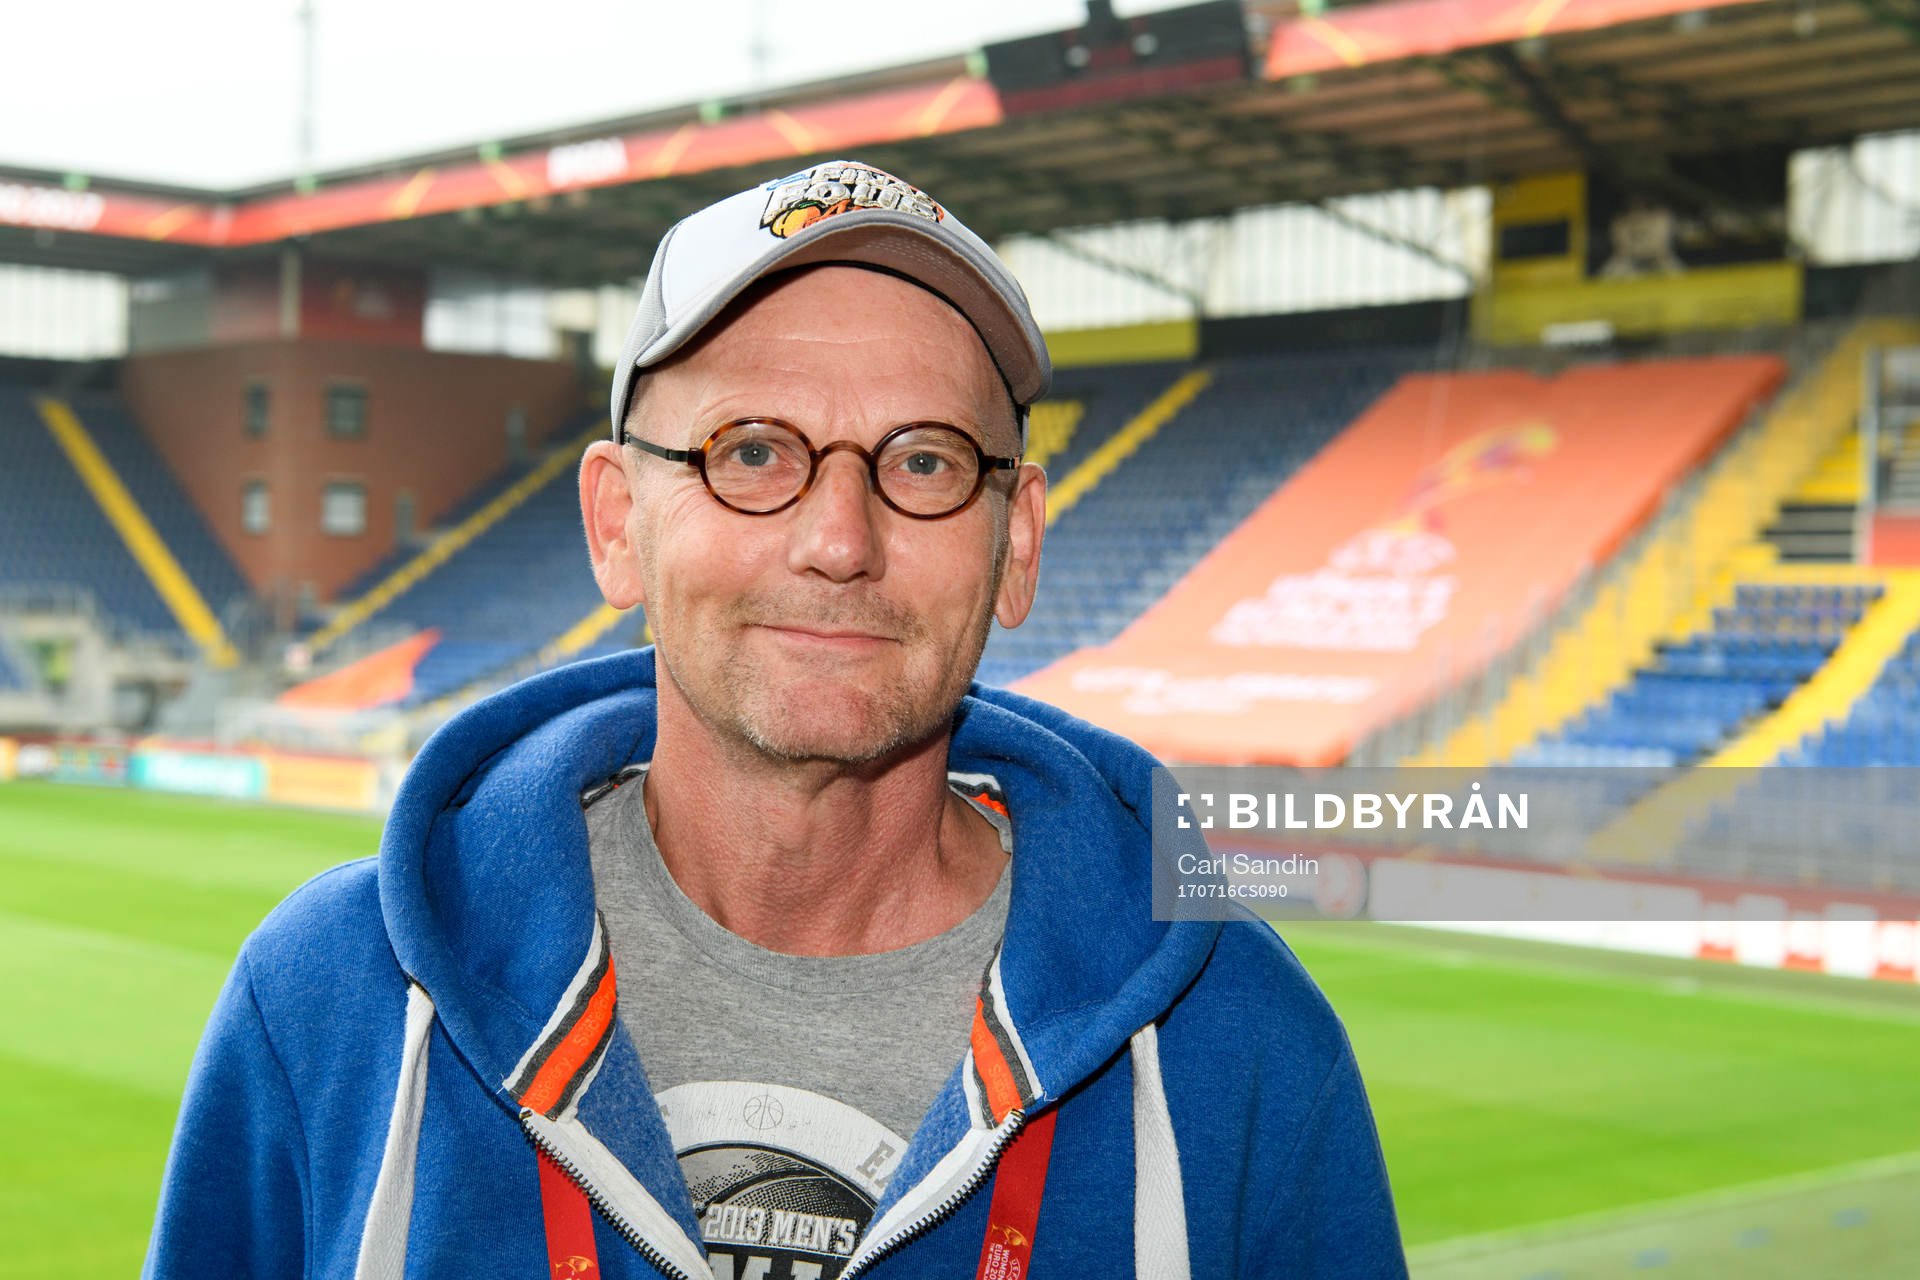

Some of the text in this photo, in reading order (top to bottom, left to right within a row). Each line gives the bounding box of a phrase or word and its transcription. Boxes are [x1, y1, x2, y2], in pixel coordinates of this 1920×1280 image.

[704, 1204, 858, 1255] 2013 MEN'S
[992, 1243, 1003, 1268] EURO
